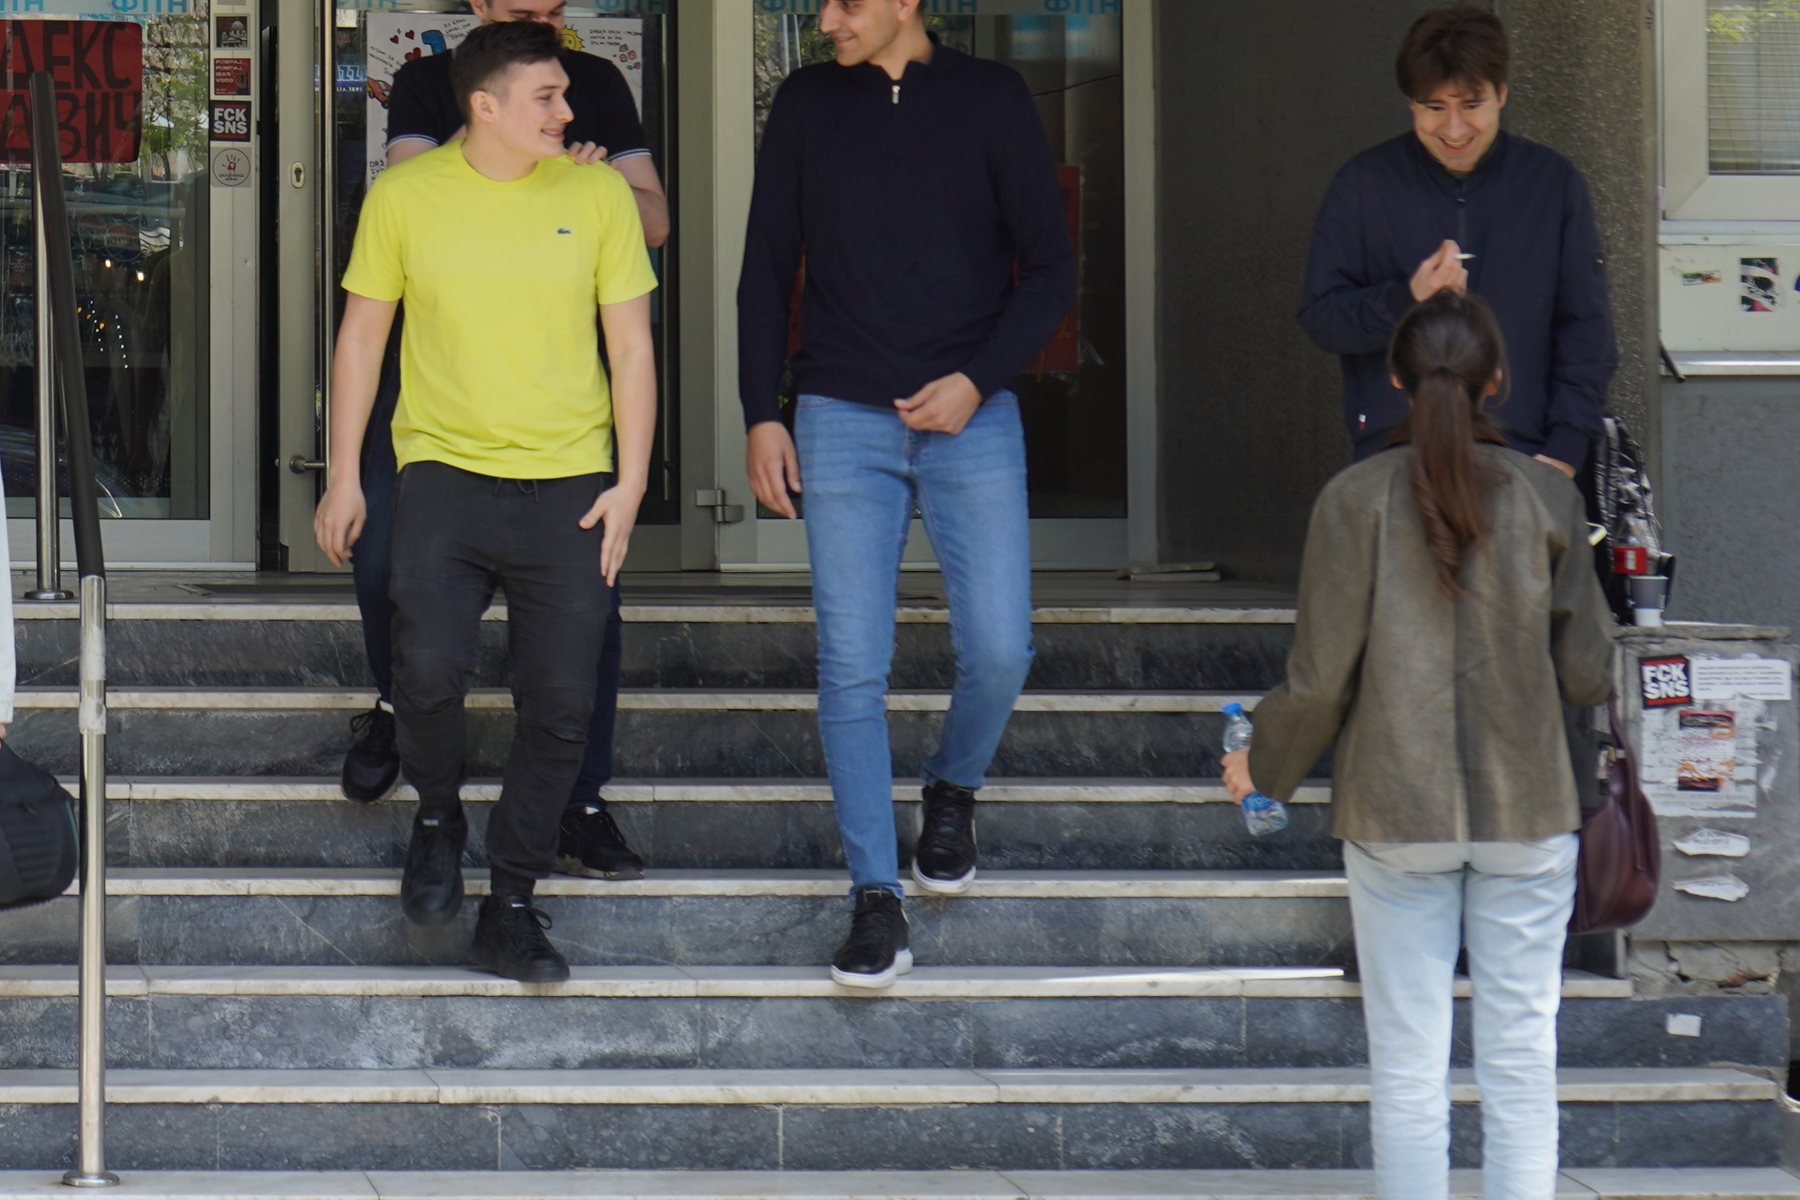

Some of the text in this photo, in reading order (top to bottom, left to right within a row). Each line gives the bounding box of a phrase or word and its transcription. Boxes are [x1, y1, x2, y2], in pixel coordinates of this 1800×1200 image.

[214, 107, 247, 122] FCK
[213, 120, 248, 135] SNS
[1642, 663, 1688, 684] FCK
[1644, 679, 1690, 700] SNS
